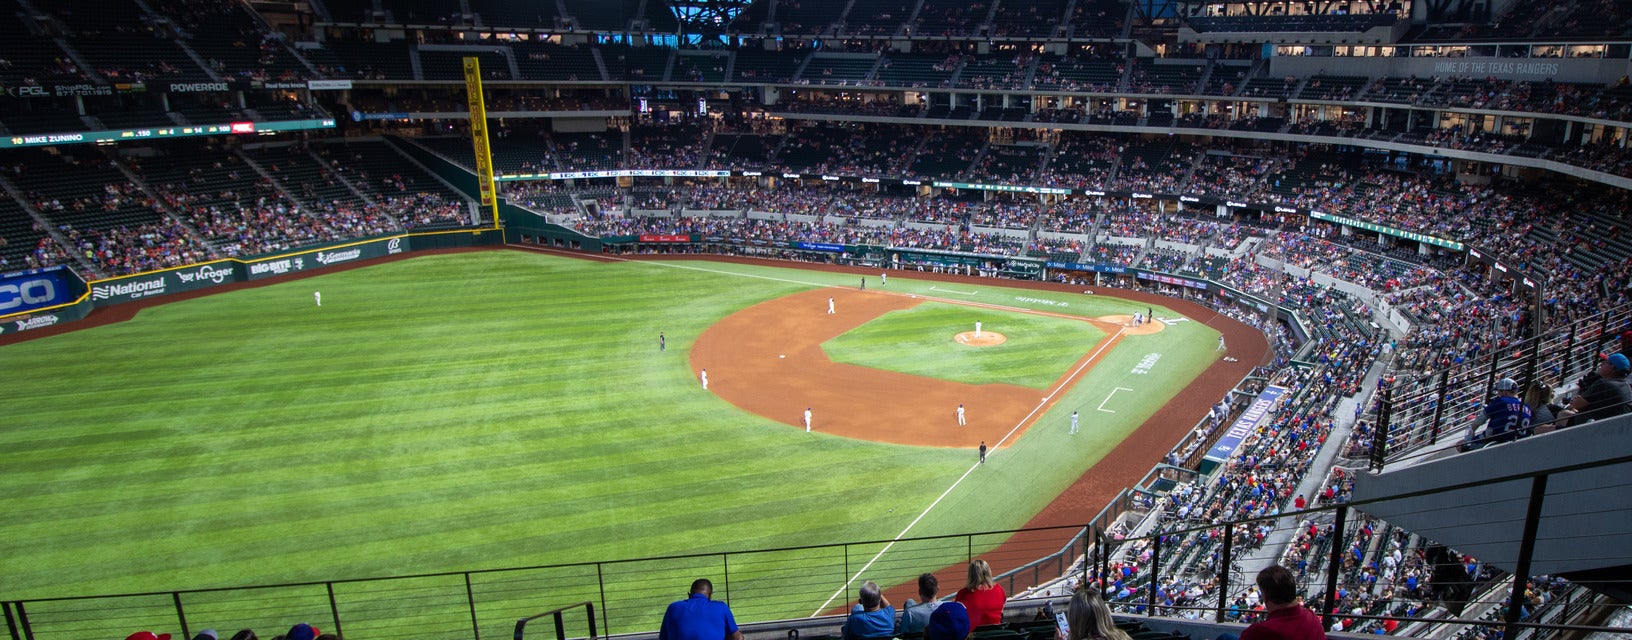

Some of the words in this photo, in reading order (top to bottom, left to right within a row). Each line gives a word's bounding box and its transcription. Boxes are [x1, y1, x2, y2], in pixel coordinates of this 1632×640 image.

[1435, 62, 1457, 73] HOME
[1459, 63, 1469, 73] OF
[1471, 63, 1485, 73] THE
[1488, 63, 1514, 74] TEXAS
[1516, 63, 1559, 75] RANGERS
[19, 86, 49, 96] PGL
[170, 82, 229, 93] POWERADE
[11, 137, 23, 145] 10
[25, 136, 47, 144] MIKE
[49, 134, 83, 143] ZUNINO
[251, 263, 270, 274] BIG
[269, 259, 291, 271] BITE
[195, 265, 233, 283] Kroger
[110, 277, 164, 296] National
[1227, 420, 1254, 439] TEXAS
[1242, 399, 1272, 422] RANGERS
